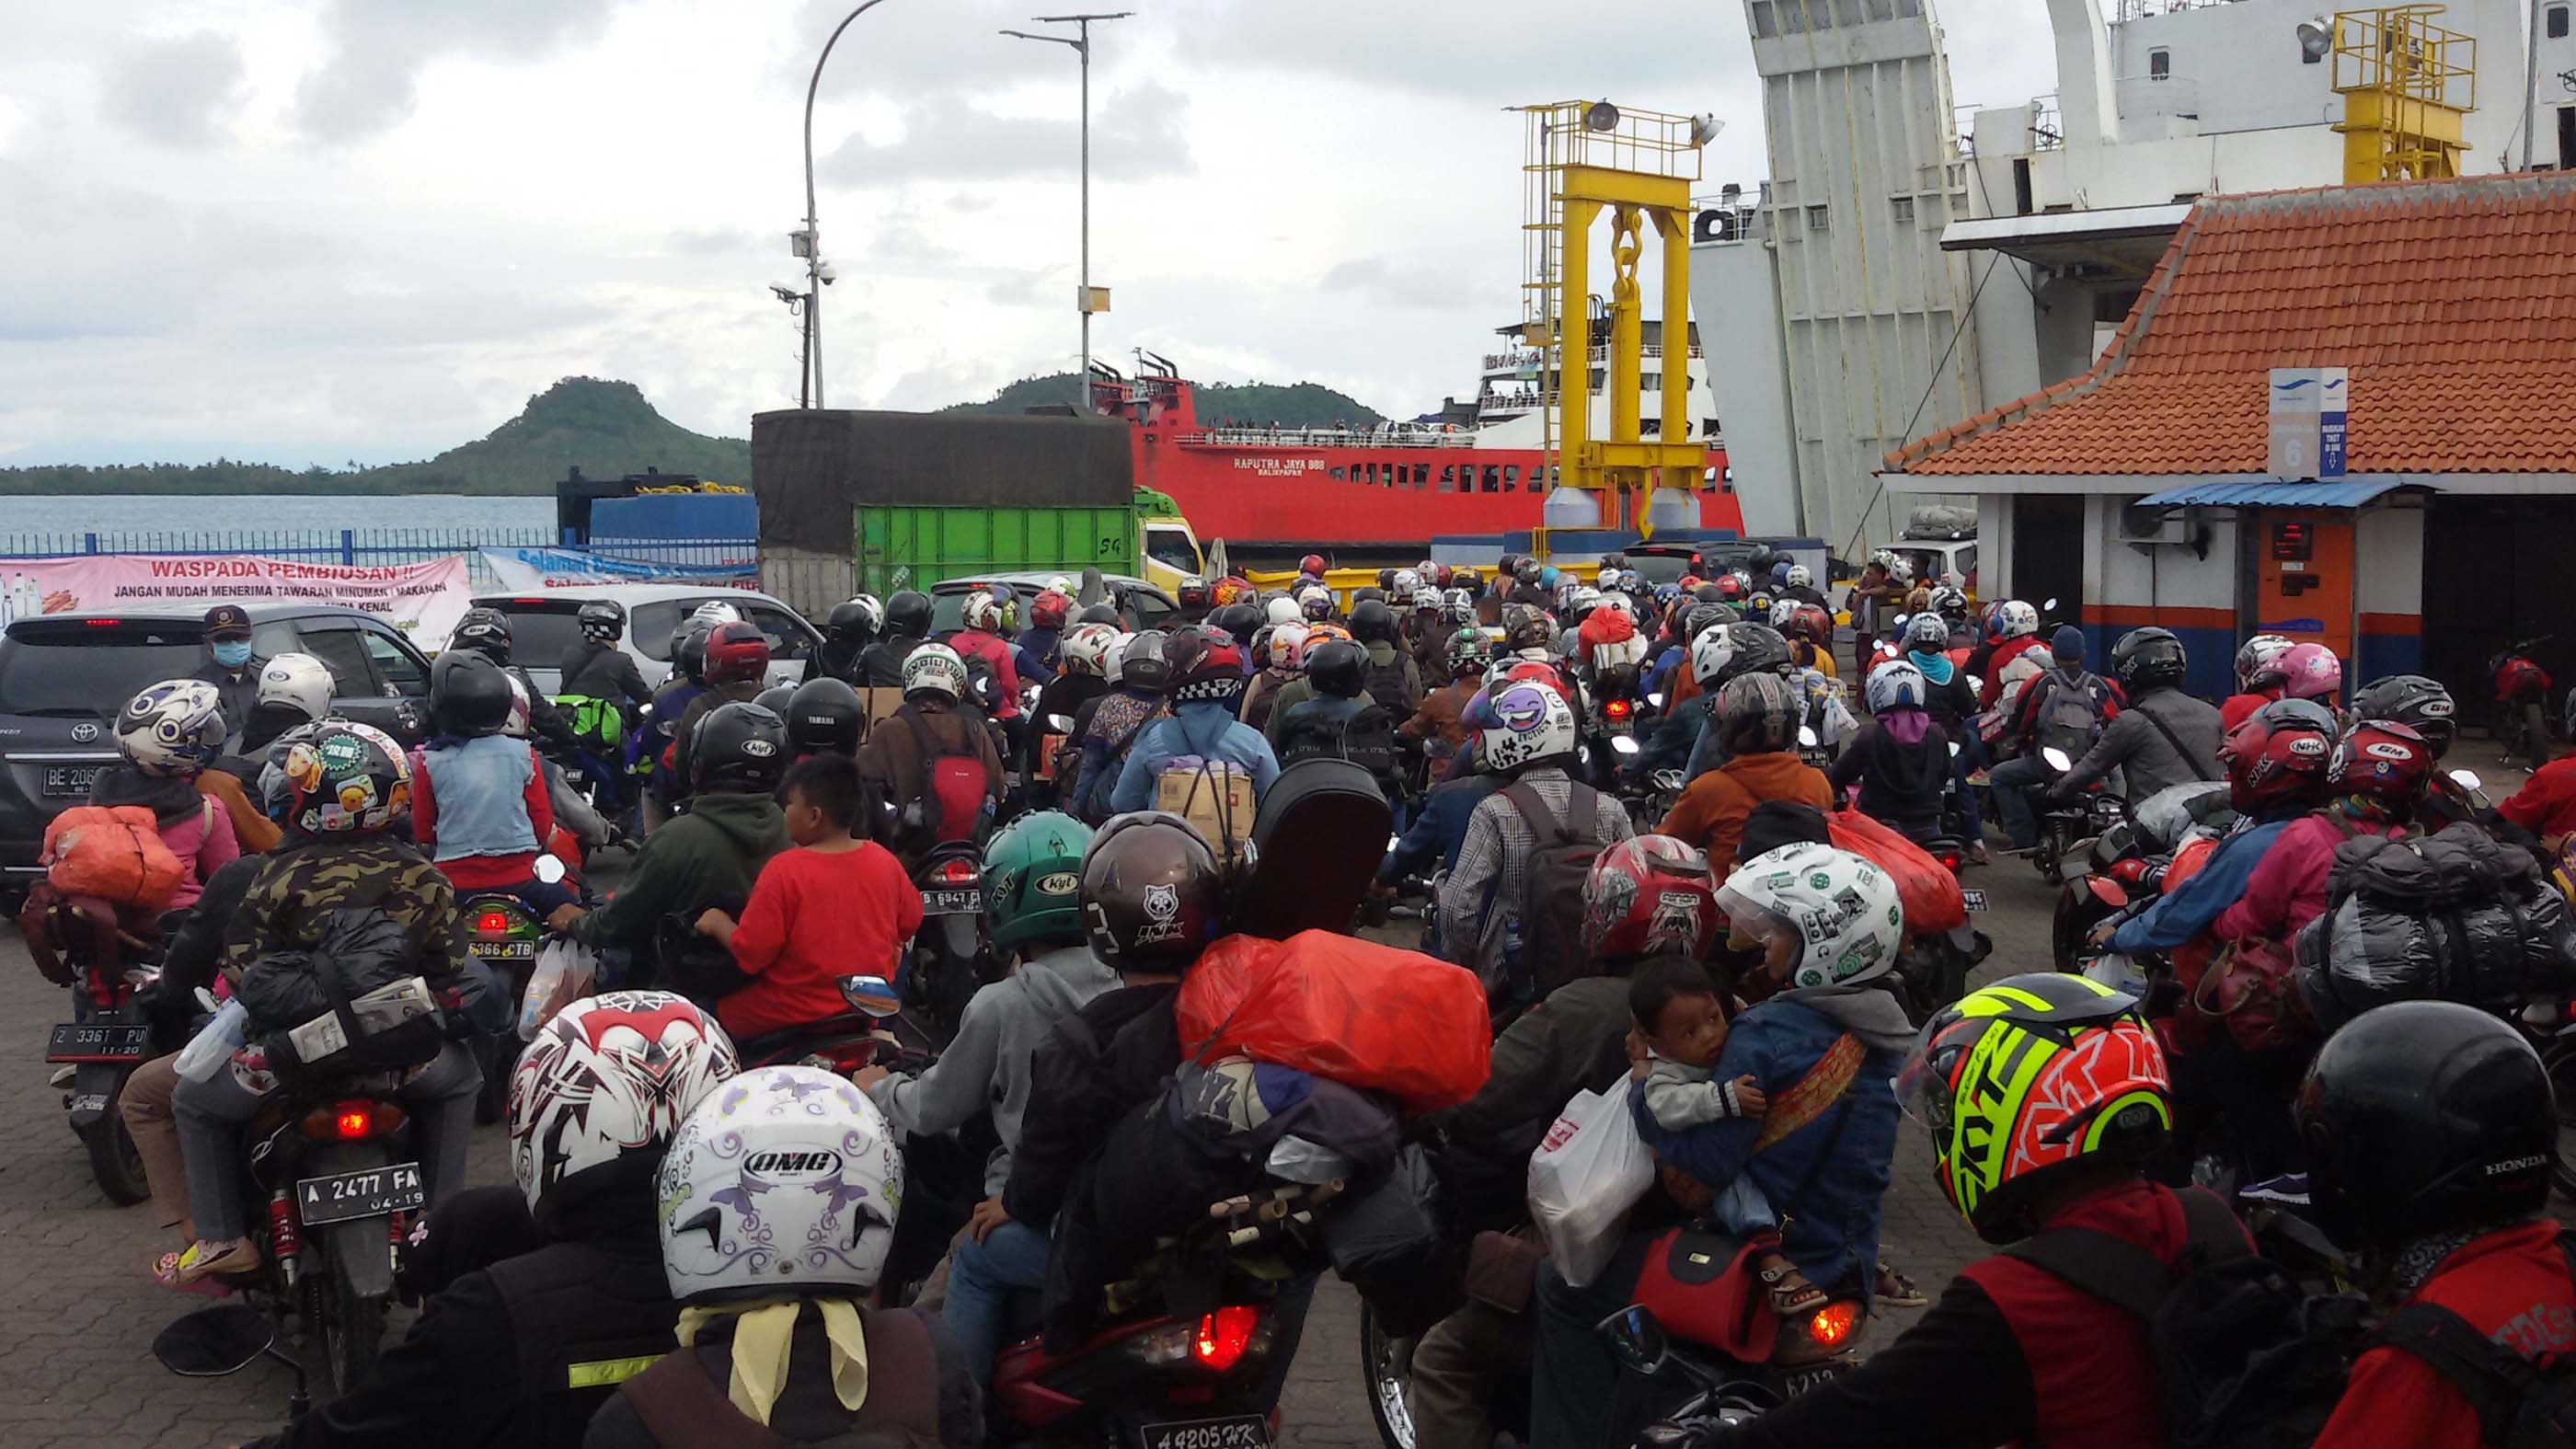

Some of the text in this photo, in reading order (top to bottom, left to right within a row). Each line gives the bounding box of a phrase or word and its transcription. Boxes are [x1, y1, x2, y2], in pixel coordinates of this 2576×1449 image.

[1234, 458, 1280, 469] RAPUTRA
[1283, 459, 1305, 470] JAYA
[151, 560, 259, 578] WASPADA
[268, 562, 397, 581] PEMBIUSAN
[114, 585, 162, 598] JANGAN
[166, 585, 208, 597] MUDAH
[212, 584, 273, 596] MENERIMA
[277, 586, 332, 598] TAWARAN
[359, 602, 393, 612] KENAL
[809, 716, 835, 725] YAMAHA
[2294, 742, 2321, 753] NHK
[2377, 745, 2405, 757] GM
[2248, 752, 2274, 788] NHK
[49, 769, 65, 786] BE
[924, 892, 931, 903] B
[937, 892, 965, 903] 6947
[56, 1030, 66, 1043] Z
[126, 1029, 145, 1043] PU
[753, 1152, 831, 1172] OMG
[2486, 1154, 2547, 1176] HONDA
[307, 1169, 419, 1203] A 2477 FA
[370, 1191, 424, 1210] 04-19
